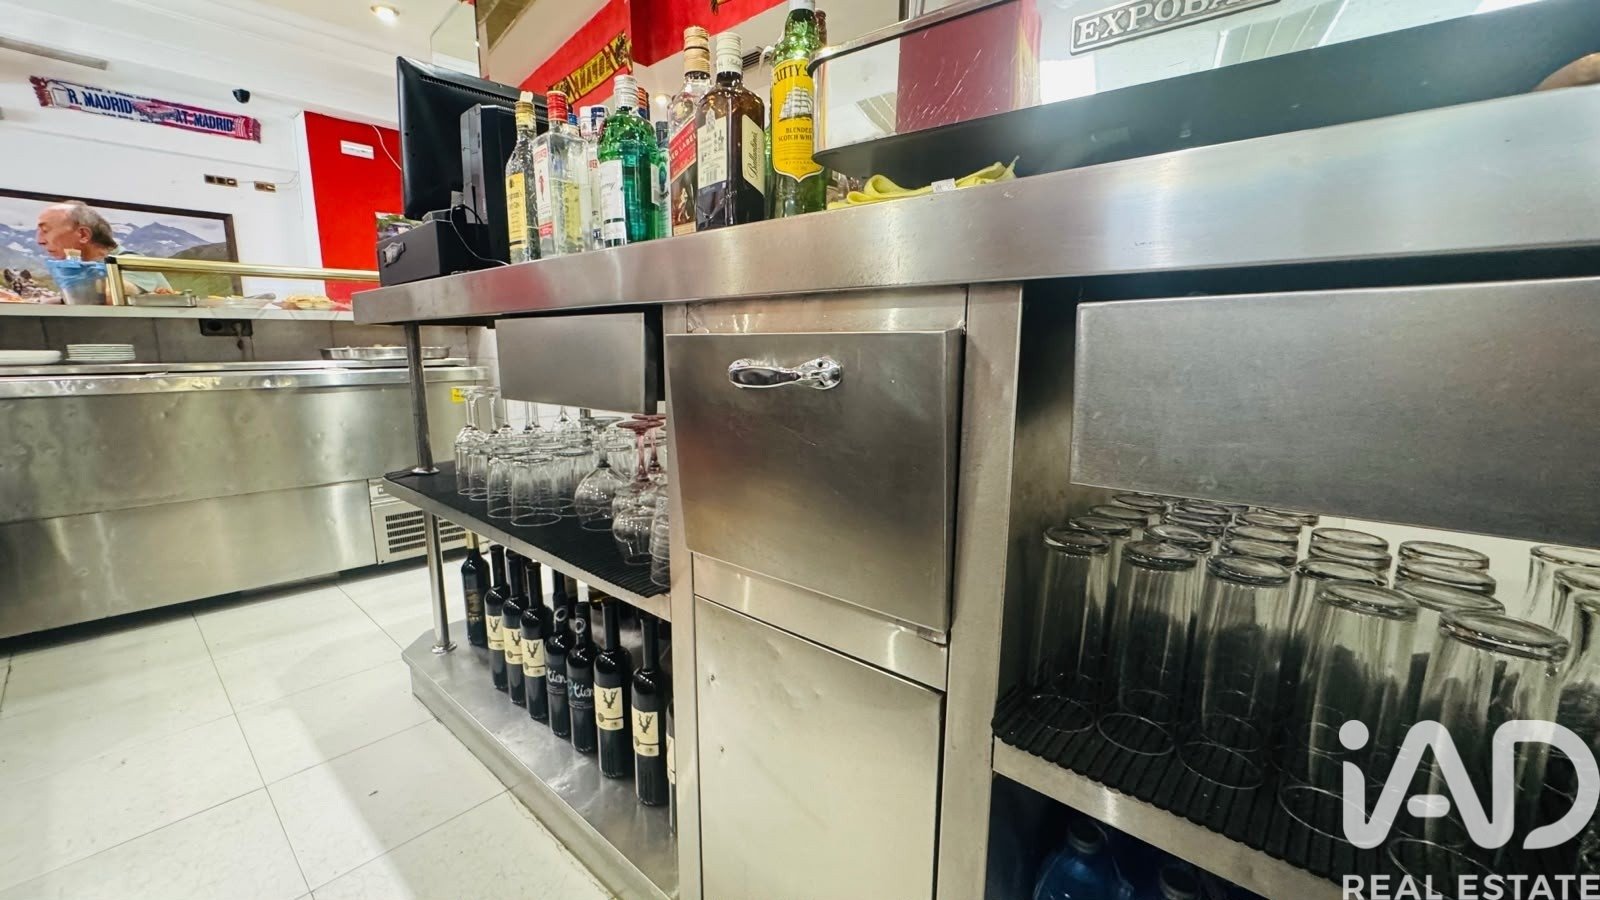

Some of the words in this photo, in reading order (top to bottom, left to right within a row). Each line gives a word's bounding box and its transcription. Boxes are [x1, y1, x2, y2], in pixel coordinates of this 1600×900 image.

[1077, 0, 1246, 45] EXPOB
[773, 63, 802, 85] CUTTY
[66, 88, 82, 105] R.
[82, 91, 133, 114] MADRID
[193, 113, 236, 132] MADRID
